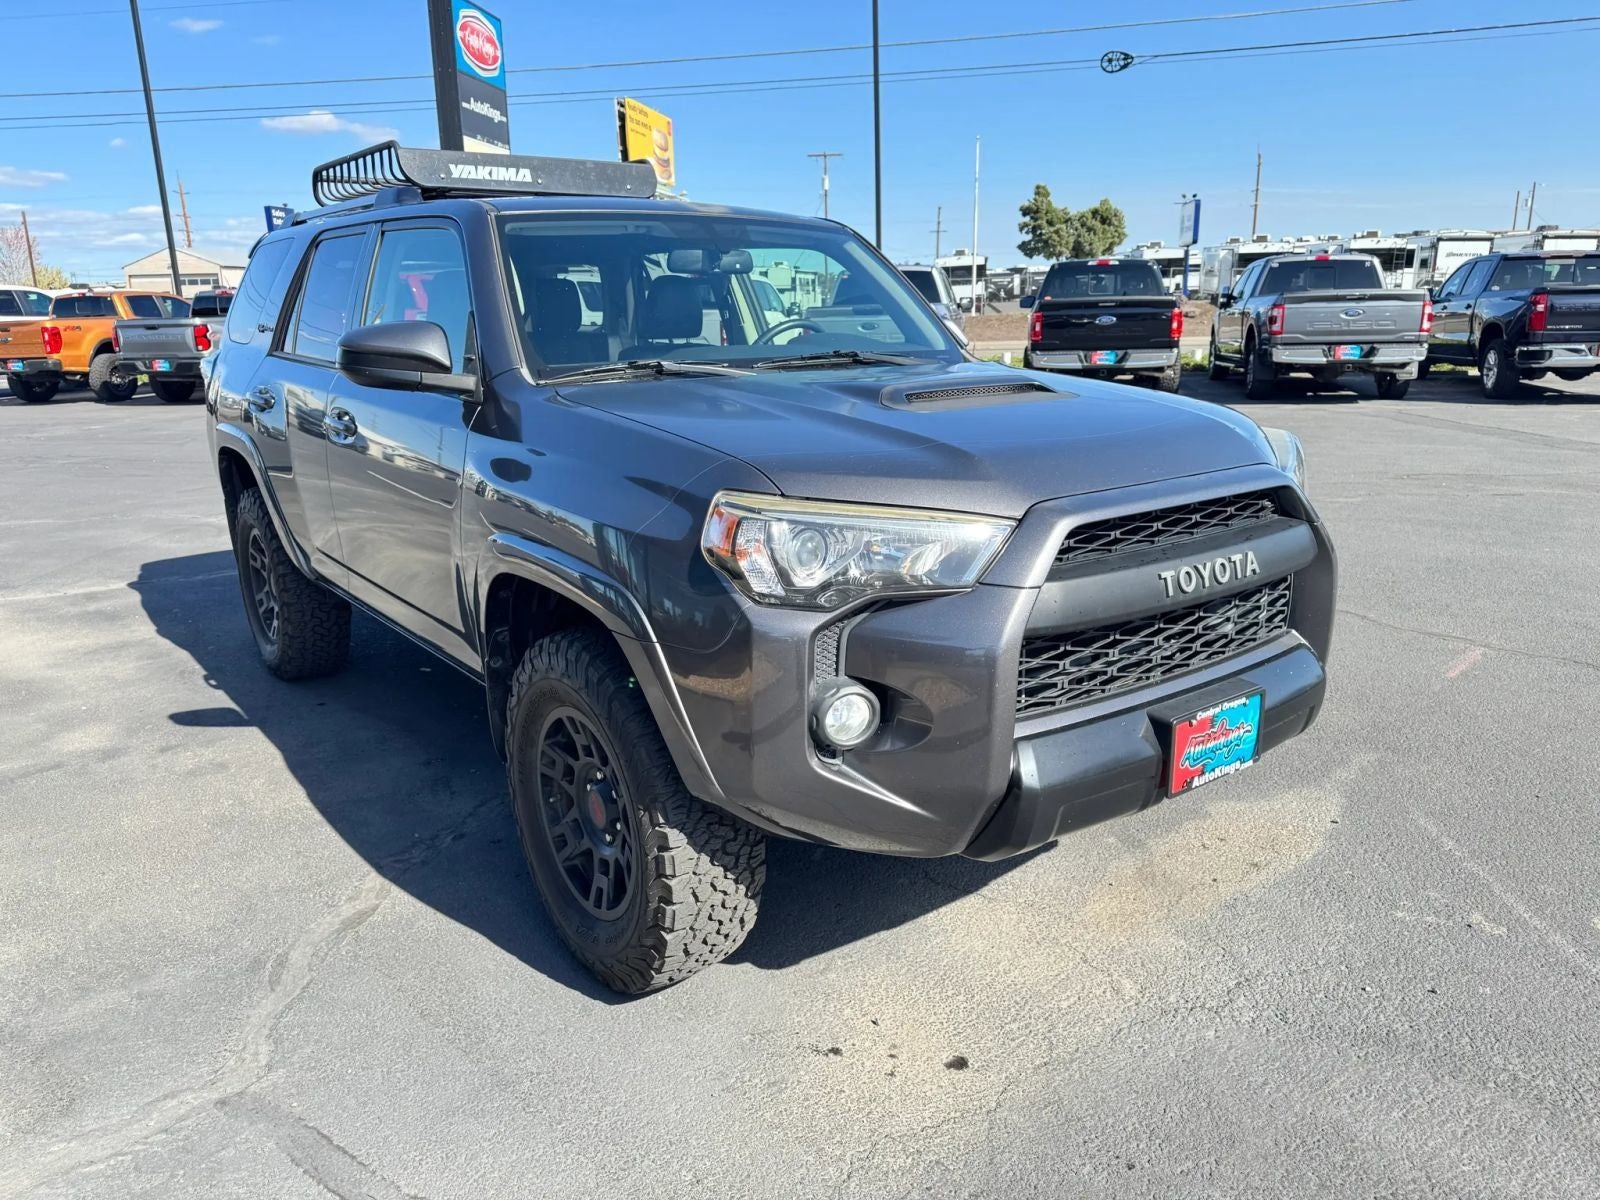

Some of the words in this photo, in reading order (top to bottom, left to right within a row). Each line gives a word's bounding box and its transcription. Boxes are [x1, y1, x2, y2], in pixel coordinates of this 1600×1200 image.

[448, 163, 533, 183] YAKIMA
[1306, 319, 1397, 330] F-150
[1158, 550, 1261, 598] TOYOTA
